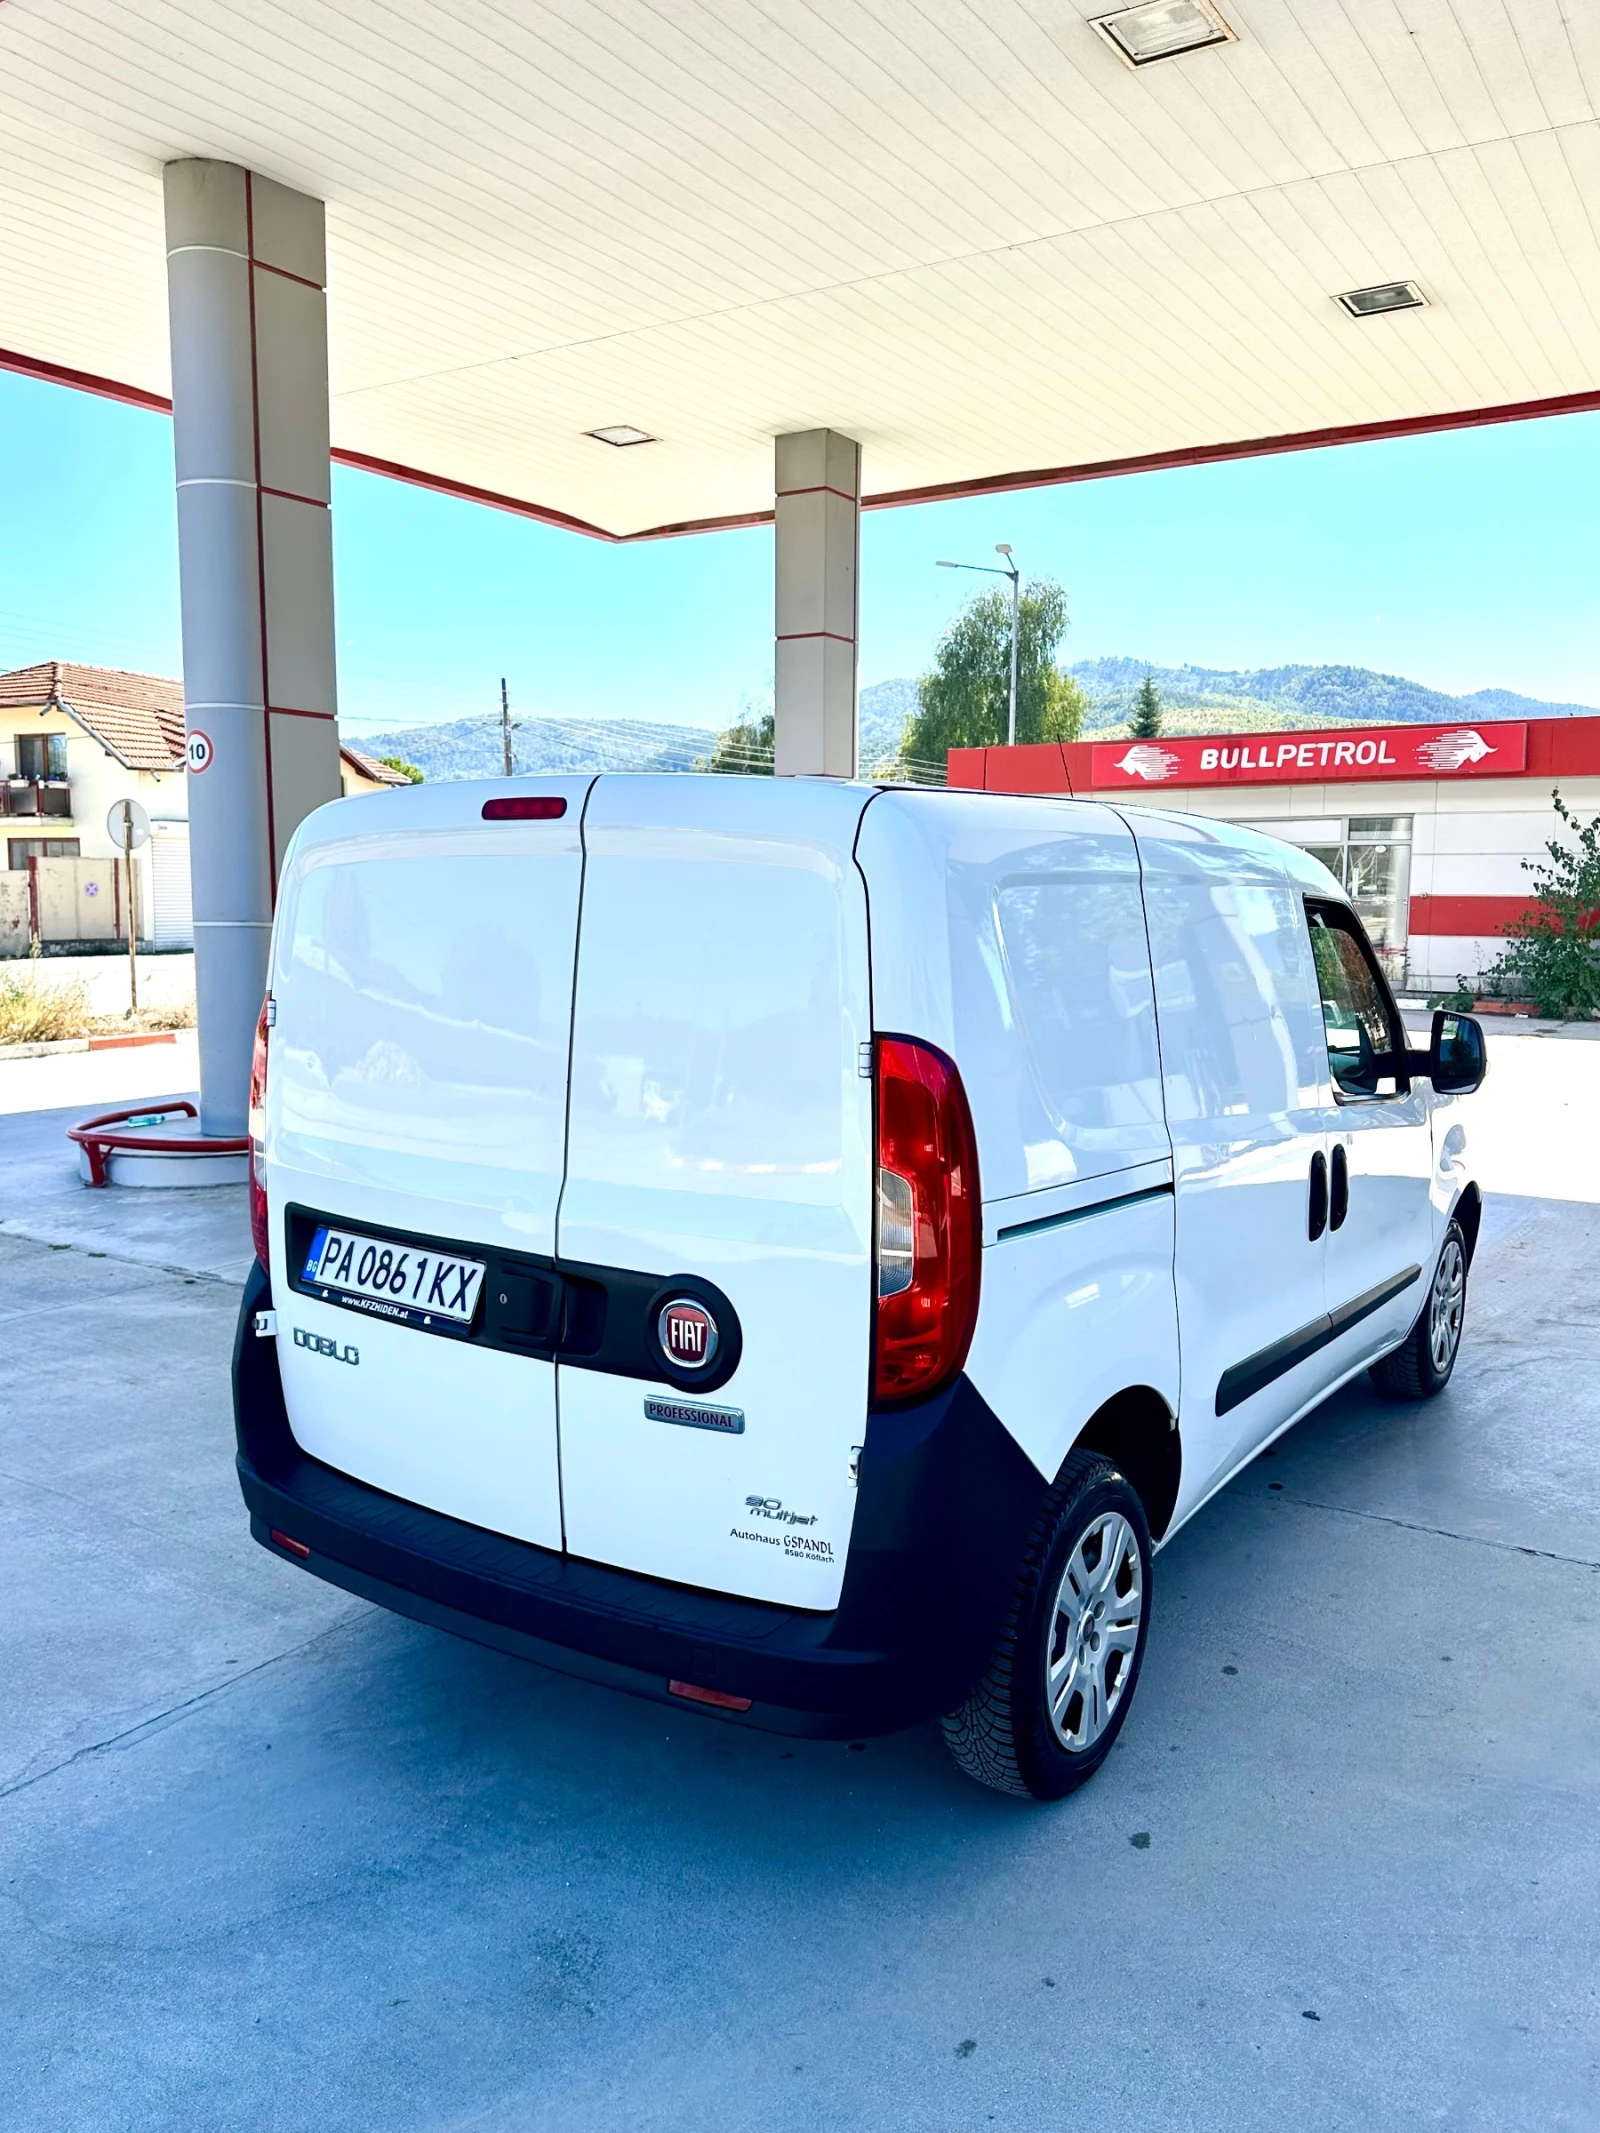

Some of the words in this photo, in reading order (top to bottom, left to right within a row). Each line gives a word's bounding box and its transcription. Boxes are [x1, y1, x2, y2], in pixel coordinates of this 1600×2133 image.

[189, 743, 205, 760] 10
[1200, 740, 1396, 770] BULLPETROL
[306, 1259, 318, 1273] BG
[670, 1318, 705, 1352] FIAT
[649, 1403, 734, 1428] PROFESSIONAL
[744, 1494, 782, 1510] 90
[729, 1528, 781, 1546] Autohaus
[783, 1535, 834, 1555] GSPANDL
[784, 1548, 804, 1559] 8580
